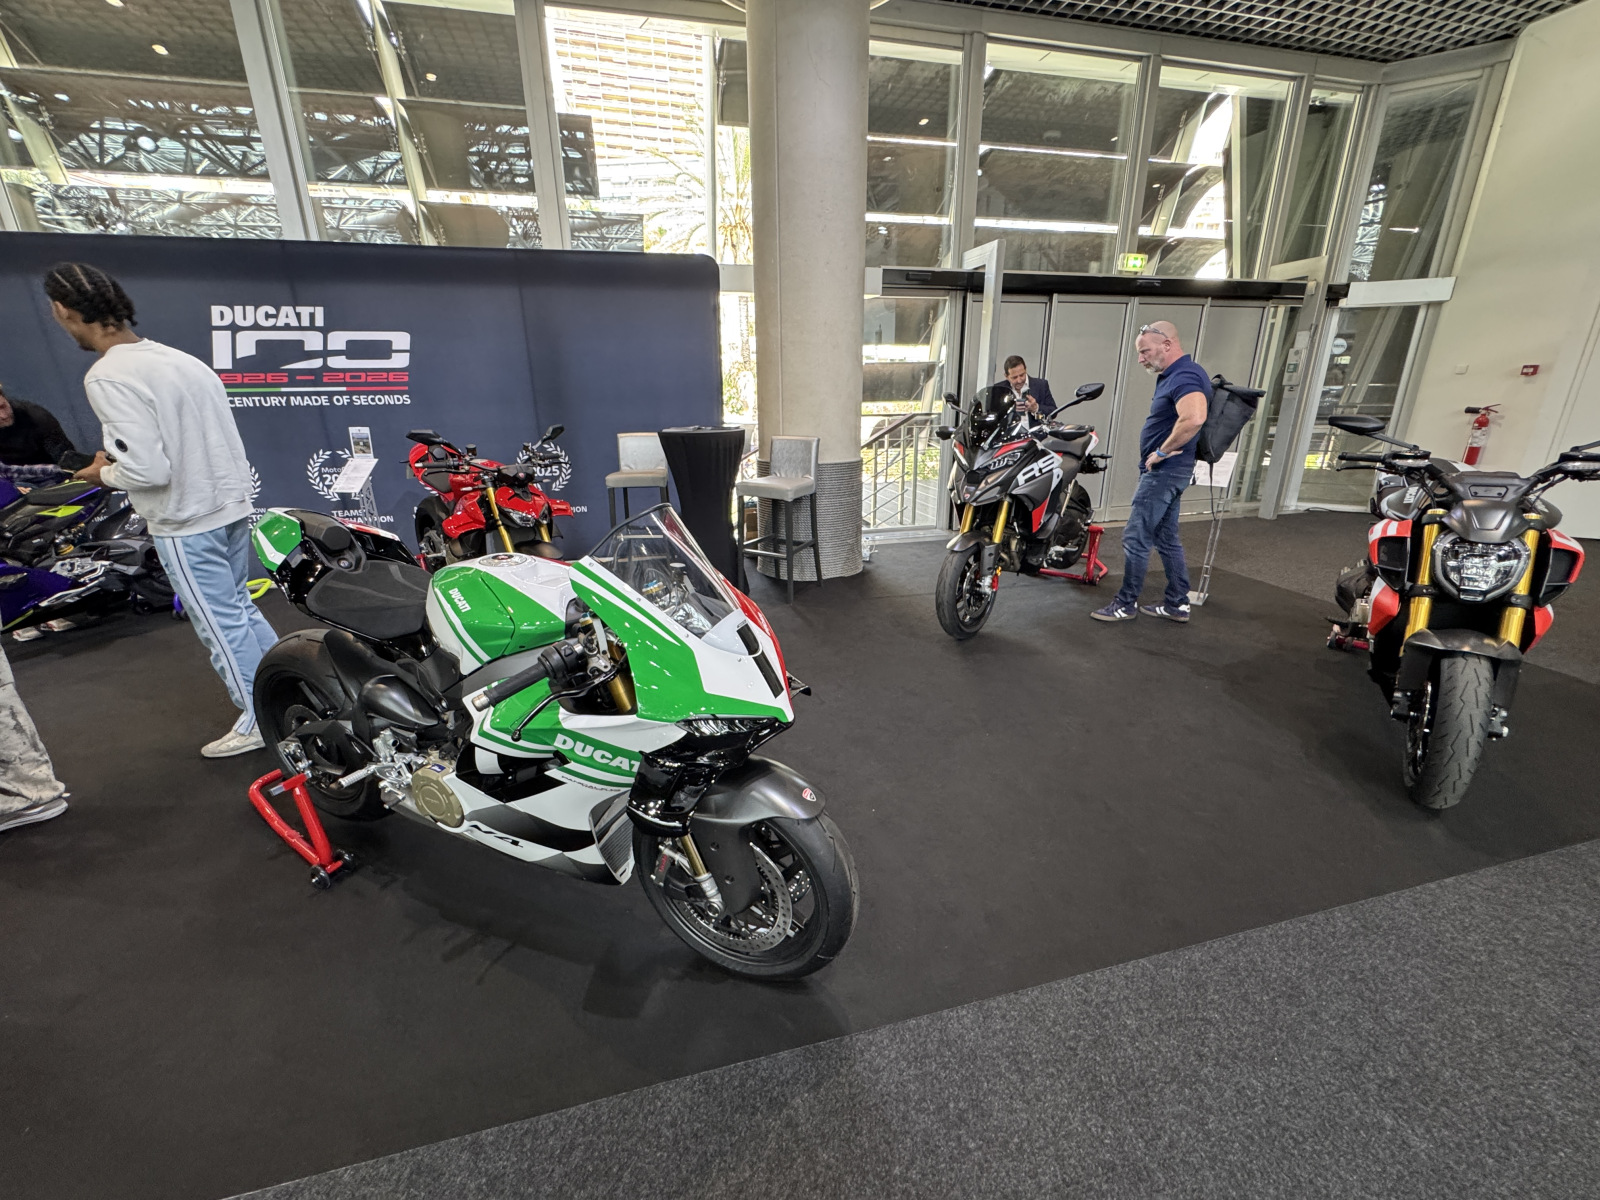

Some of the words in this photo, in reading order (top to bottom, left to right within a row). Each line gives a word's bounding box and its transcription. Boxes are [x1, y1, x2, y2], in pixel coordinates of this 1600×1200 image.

[211, 305, 324, 327] DUCATI
[218, 372, 289, 384] 926
[323, 372, 409, 383] 2026
[228, 396, 287, 408] CENTURY
[290, 395, 330, 406] MADE
[333, 395, 351, 406] OF
[353, 394, 411, 406] SECONDS
[448, 587, 472, 613] DUCATI
[553, 733, 641, 773] DUCAT
